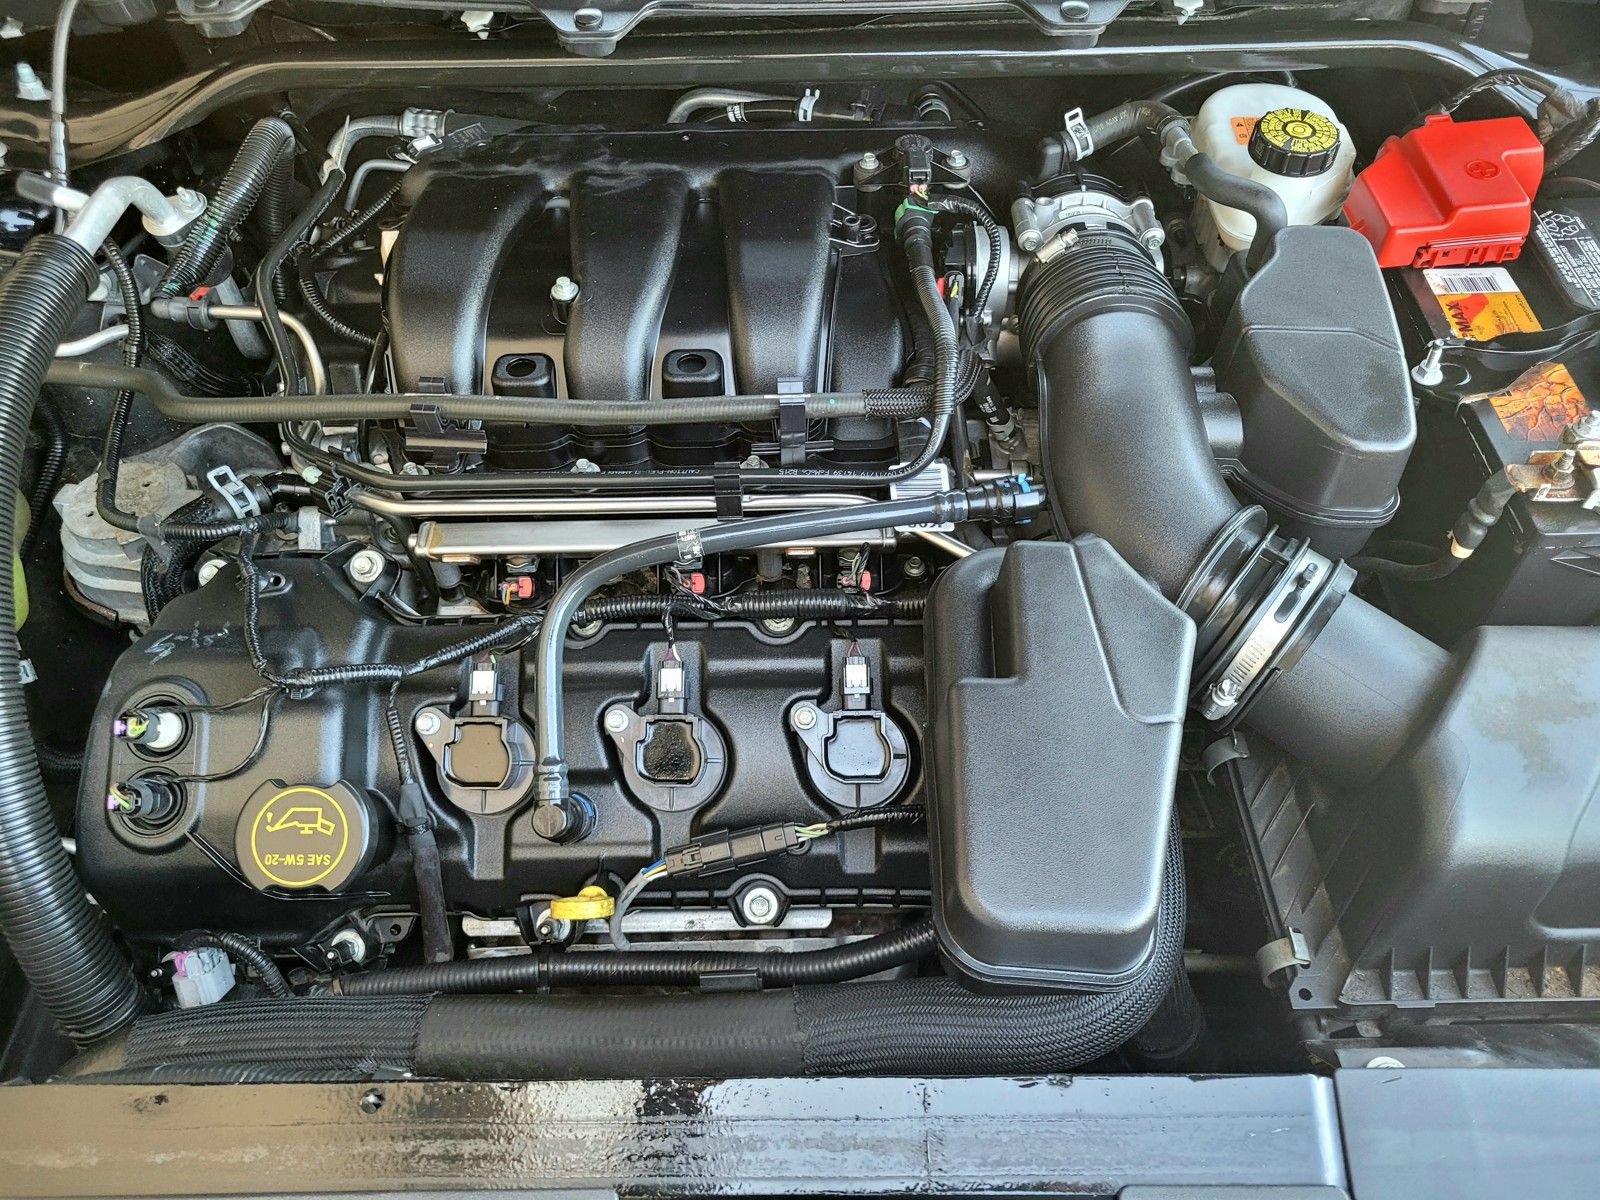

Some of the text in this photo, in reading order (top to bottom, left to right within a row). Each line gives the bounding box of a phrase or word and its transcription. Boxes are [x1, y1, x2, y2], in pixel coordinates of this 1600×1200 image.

[1446, 302, 1473, 332] MAX
[264, 853, 331, 866] SAE 5W-20
